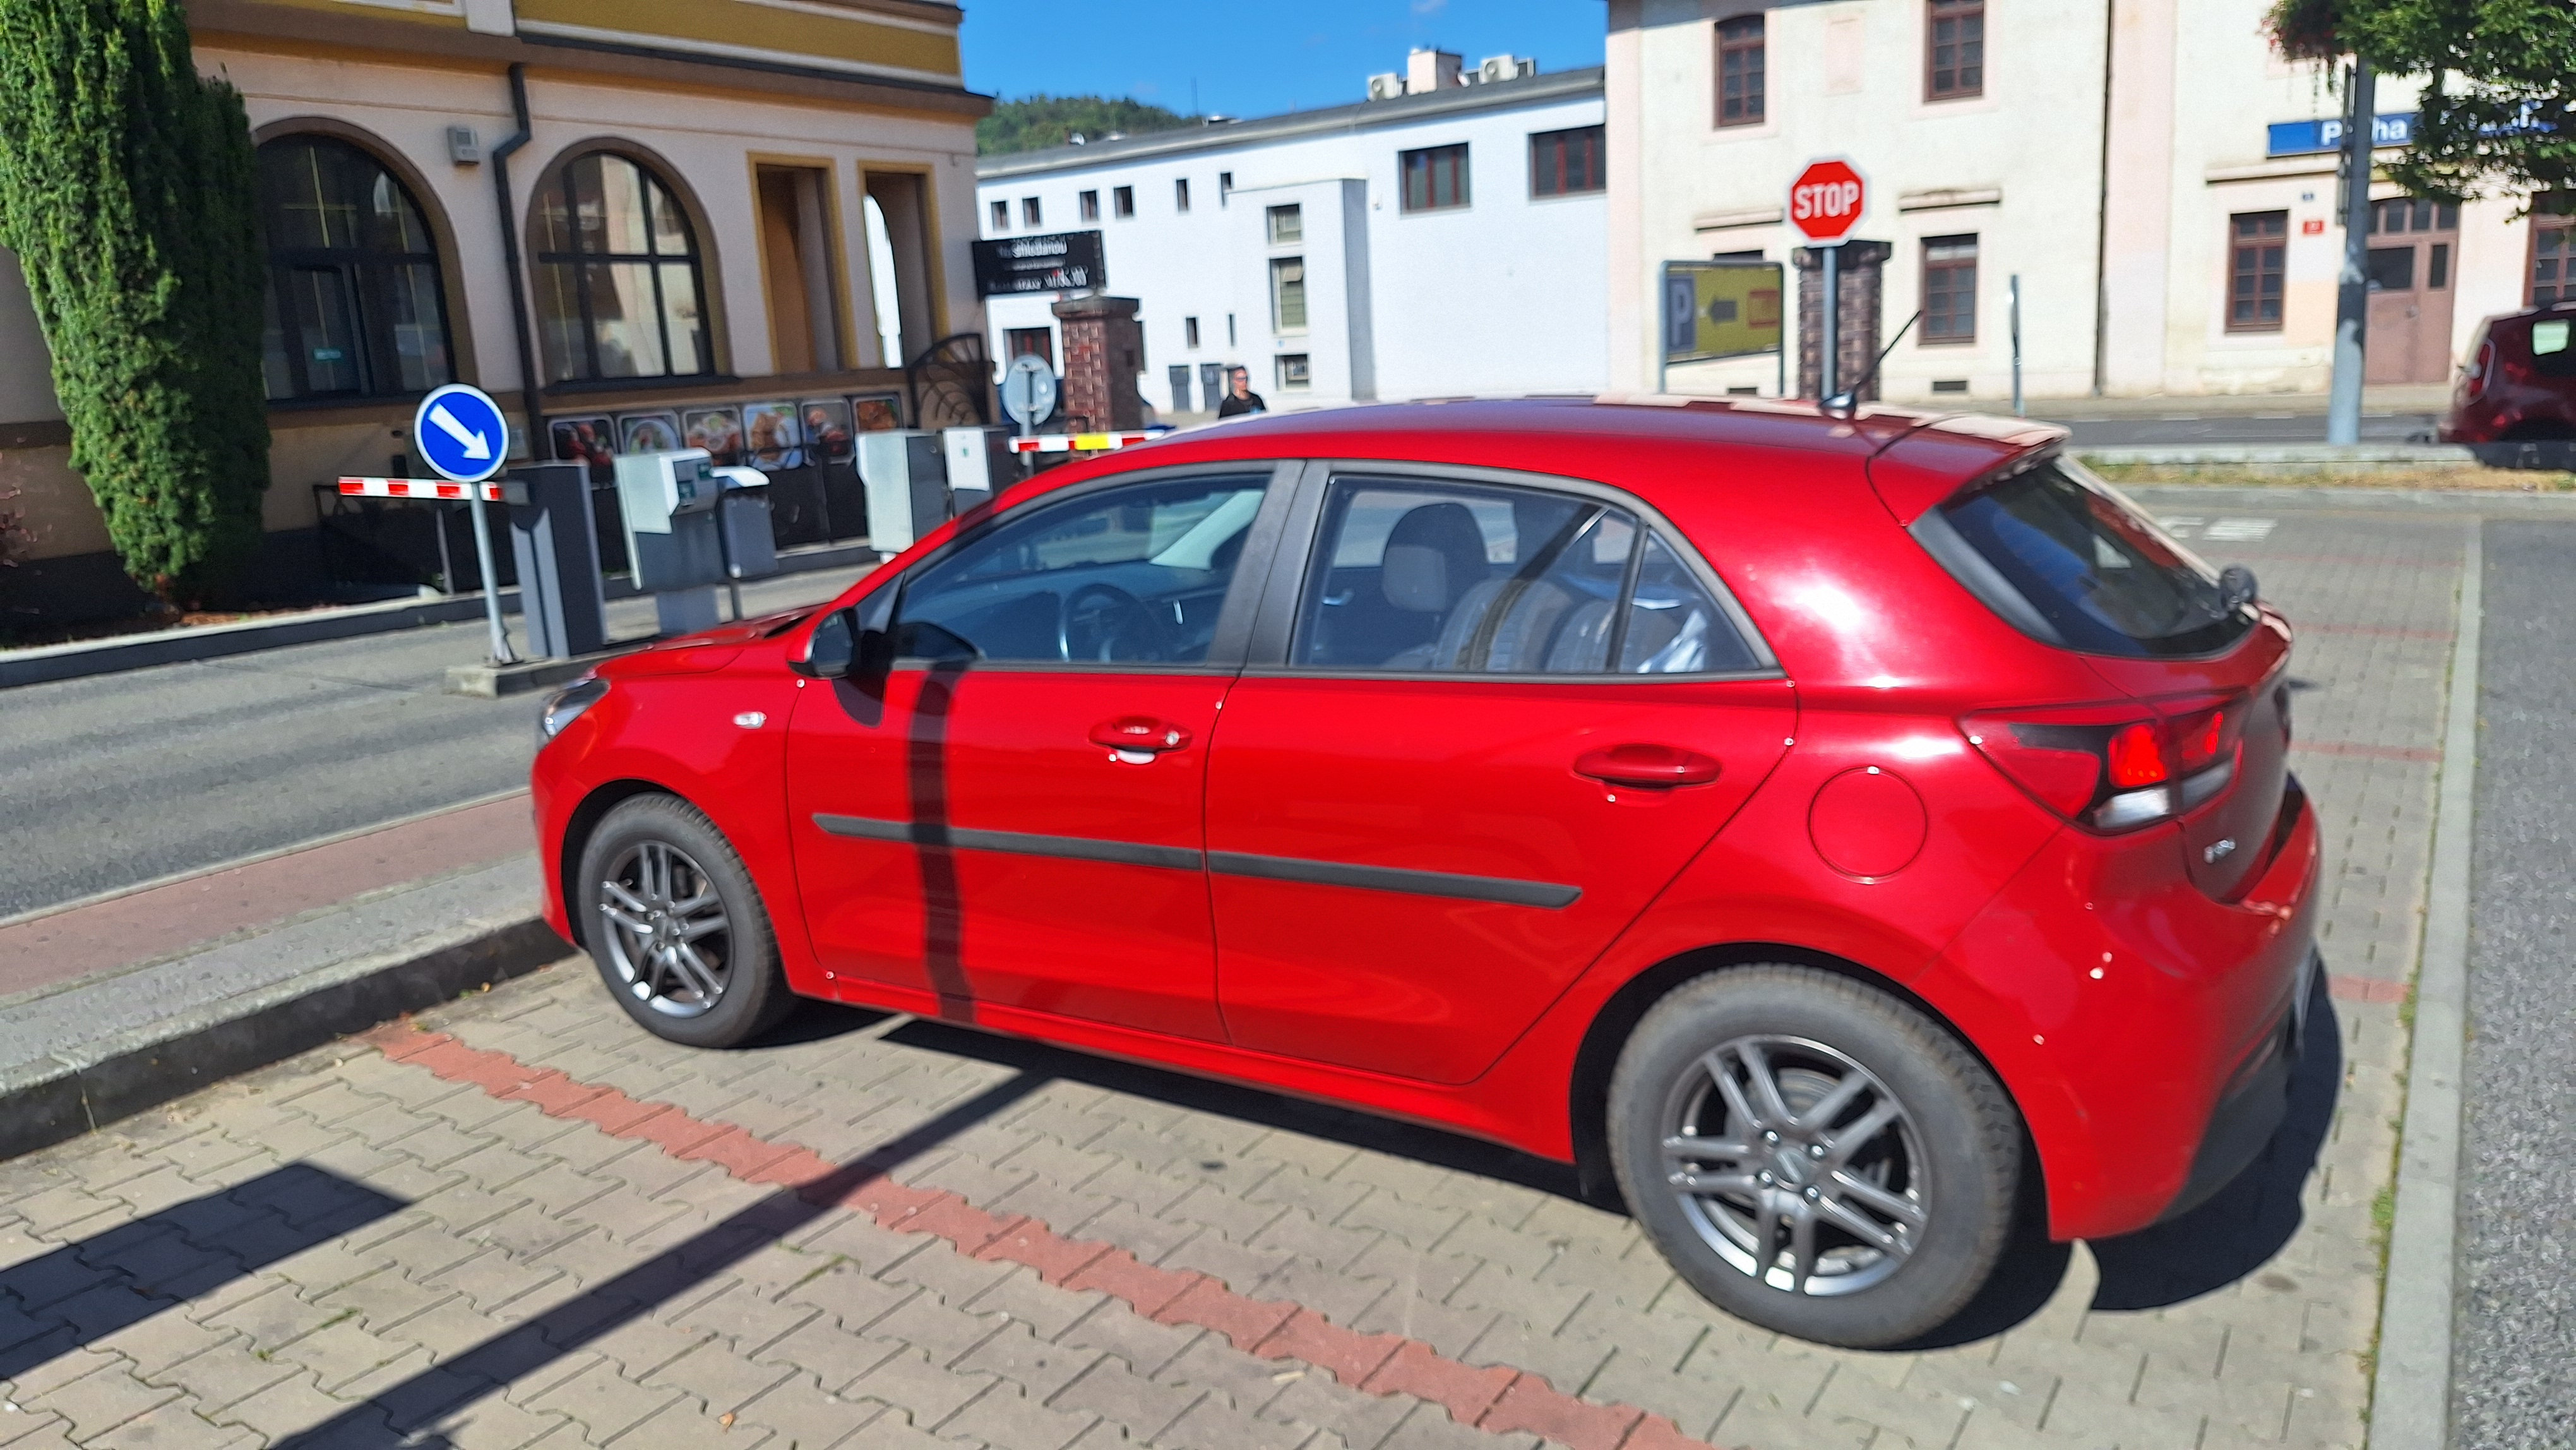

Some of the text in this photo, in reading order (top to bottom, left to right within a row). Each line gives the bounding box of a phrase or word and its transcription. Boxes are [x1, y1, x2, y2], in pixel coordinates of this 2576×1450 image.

[2321, 117, 2408, 146] Pha
[1794, 181, 1859, 220] STOP
[1669, 283, 1692, 347] P
